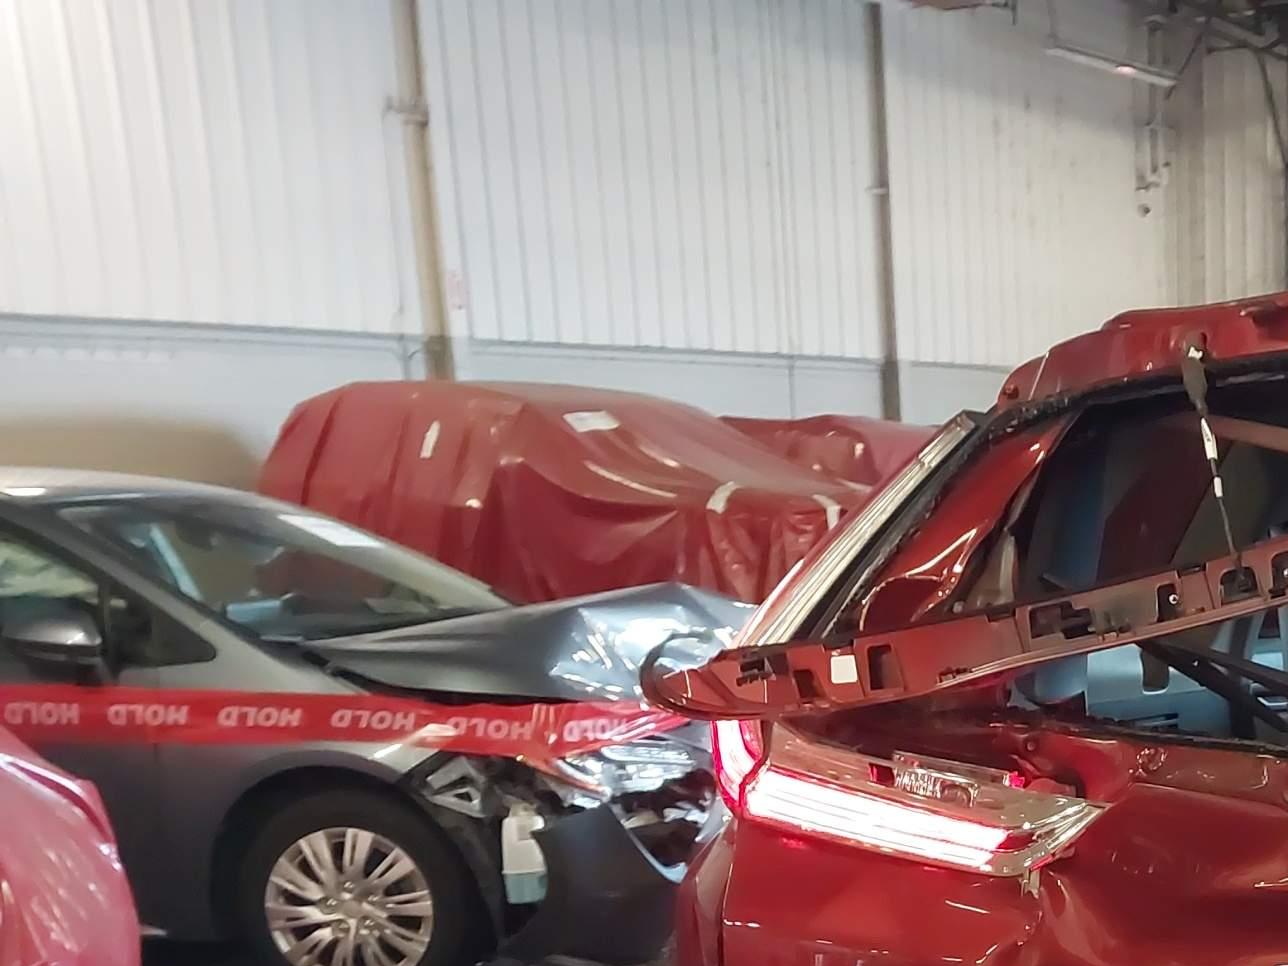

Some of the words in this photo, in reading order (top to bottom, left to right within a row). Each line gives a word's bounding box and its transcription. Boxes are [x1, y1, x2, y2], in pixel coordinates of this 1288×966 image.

[4, 702, 80, 725] HOLD
[107, 703, 191, 726] HOLD
[217, 705, 303, 727] HOLD
[330, 708, 418, 731] HOLD
[449, 716, 533, 740] HOLD
